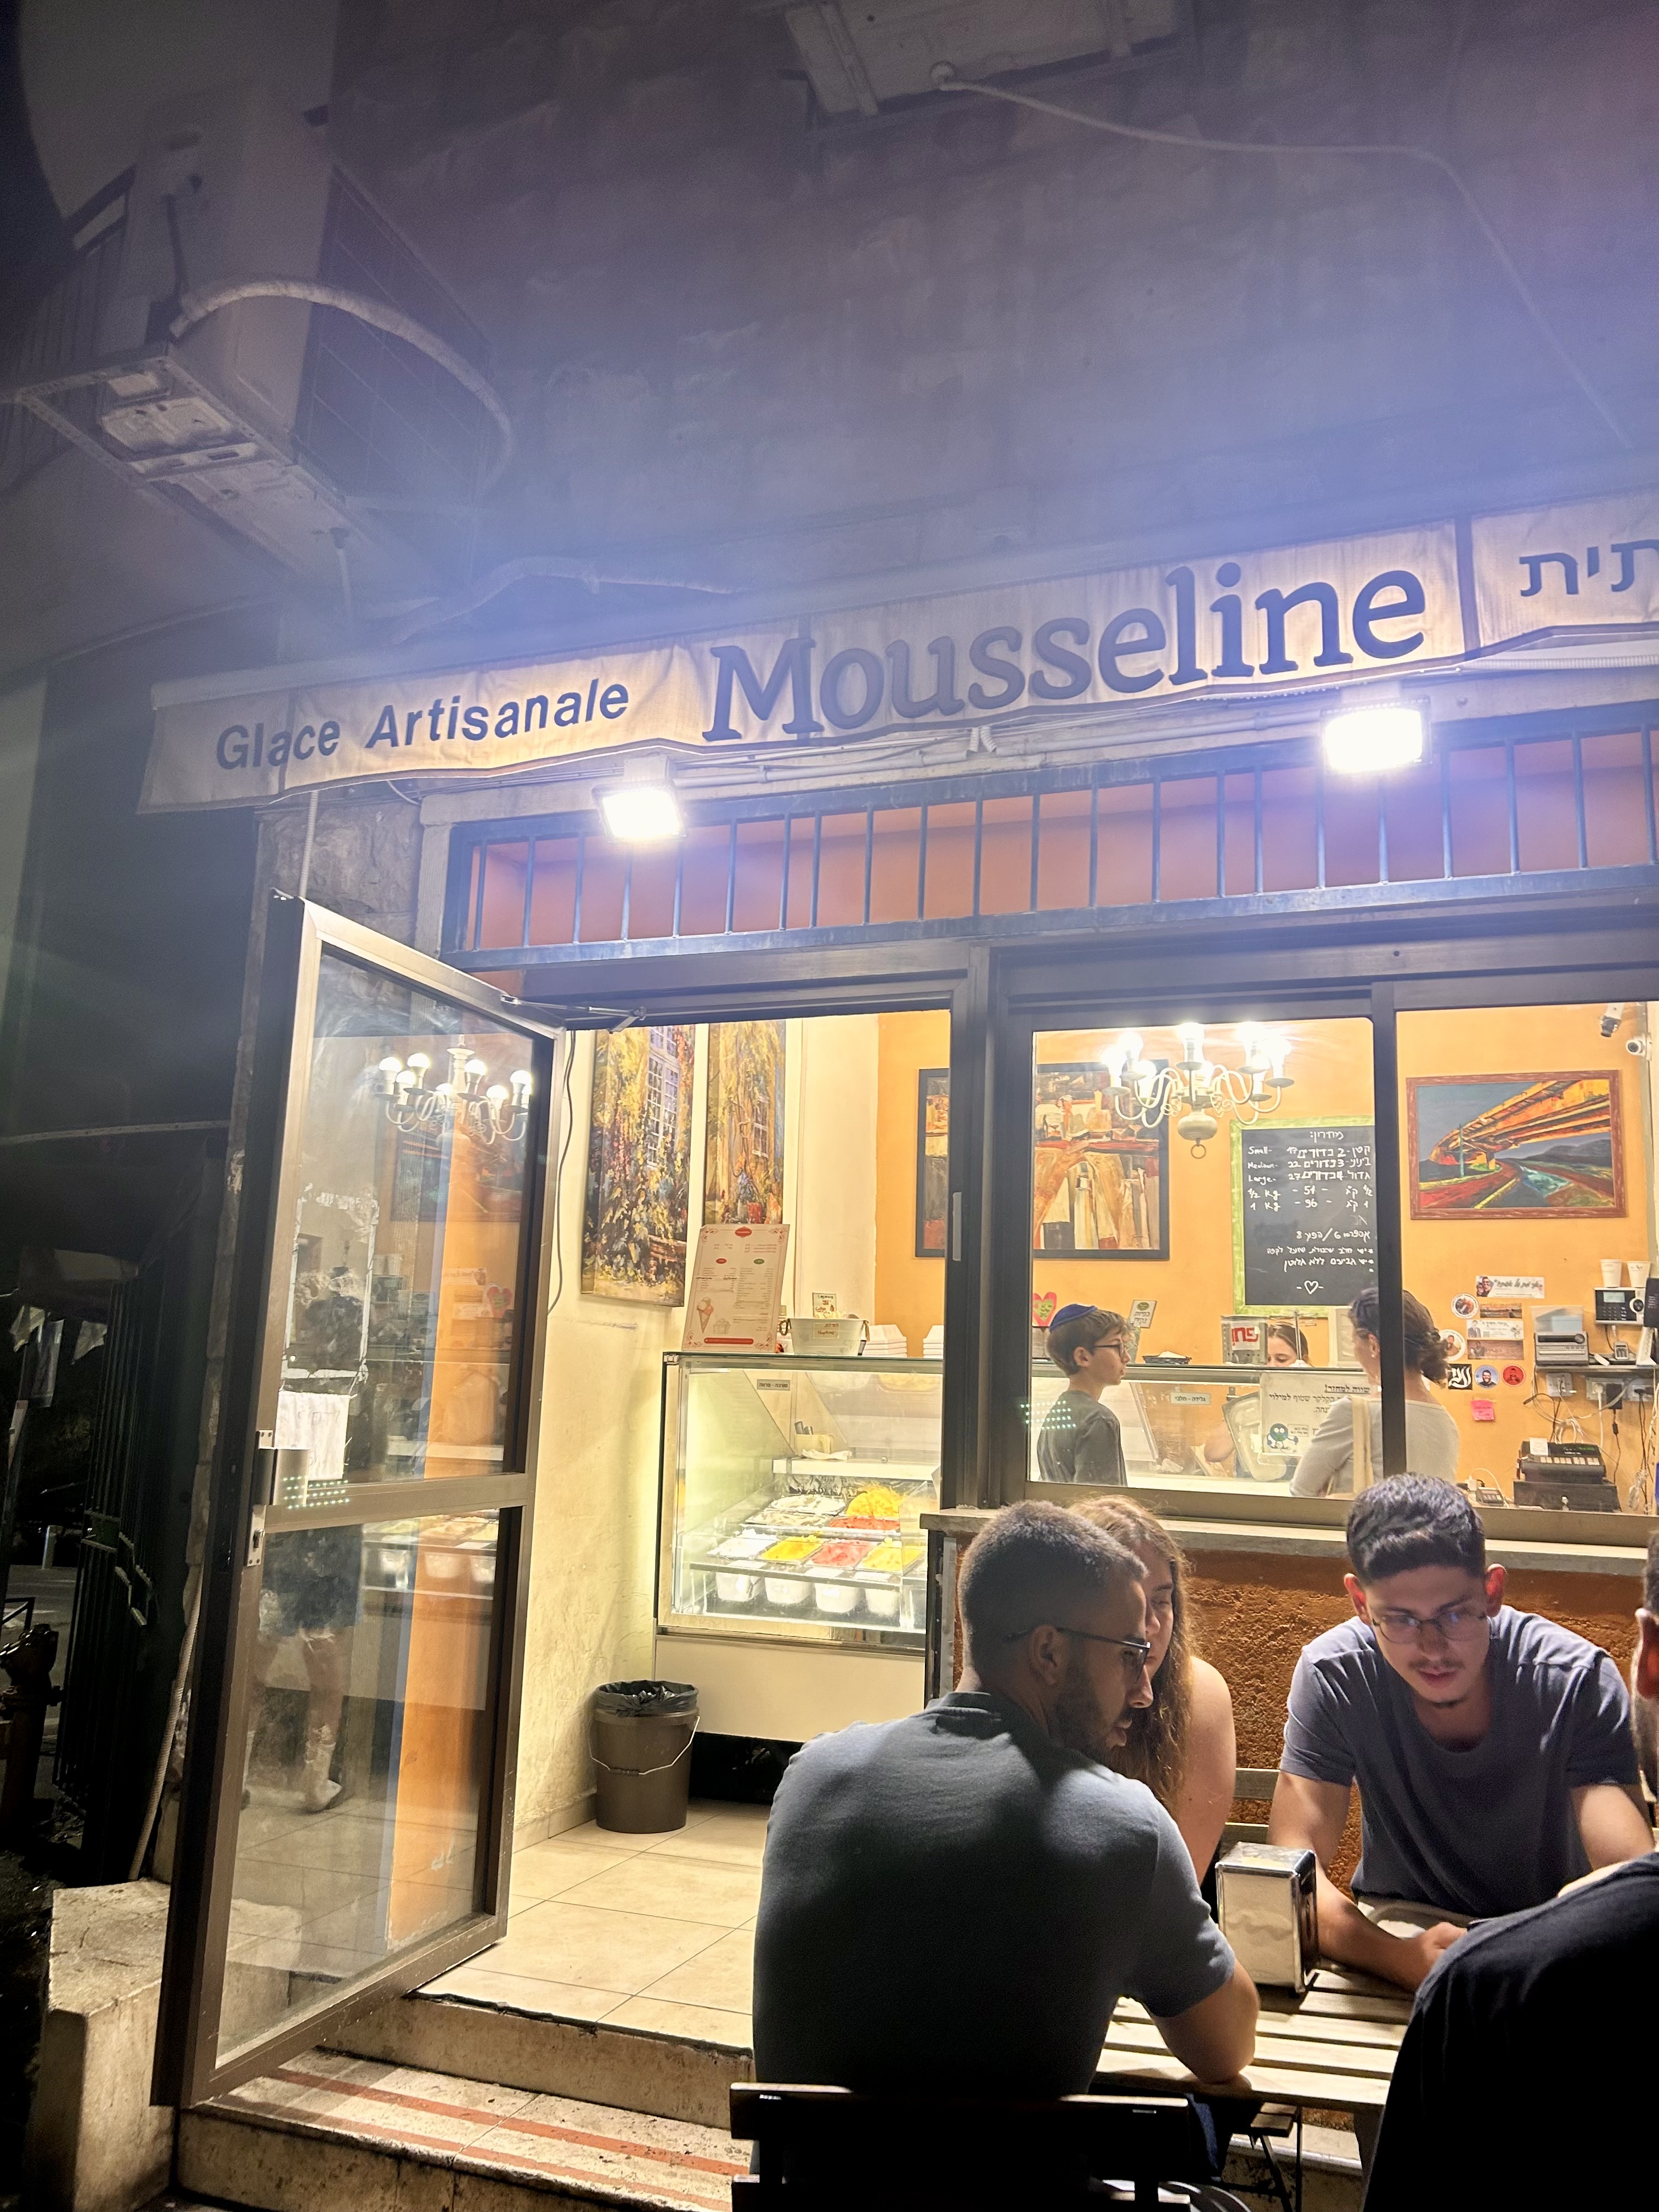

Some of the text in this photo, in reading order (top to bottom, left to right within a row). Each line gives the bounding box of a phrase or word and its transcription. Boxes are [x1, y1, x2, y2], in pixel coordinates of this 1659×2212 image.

[702, 561, 1426, 742] Mousseline
[216, 678, 629, 771] Glace Artisanale
